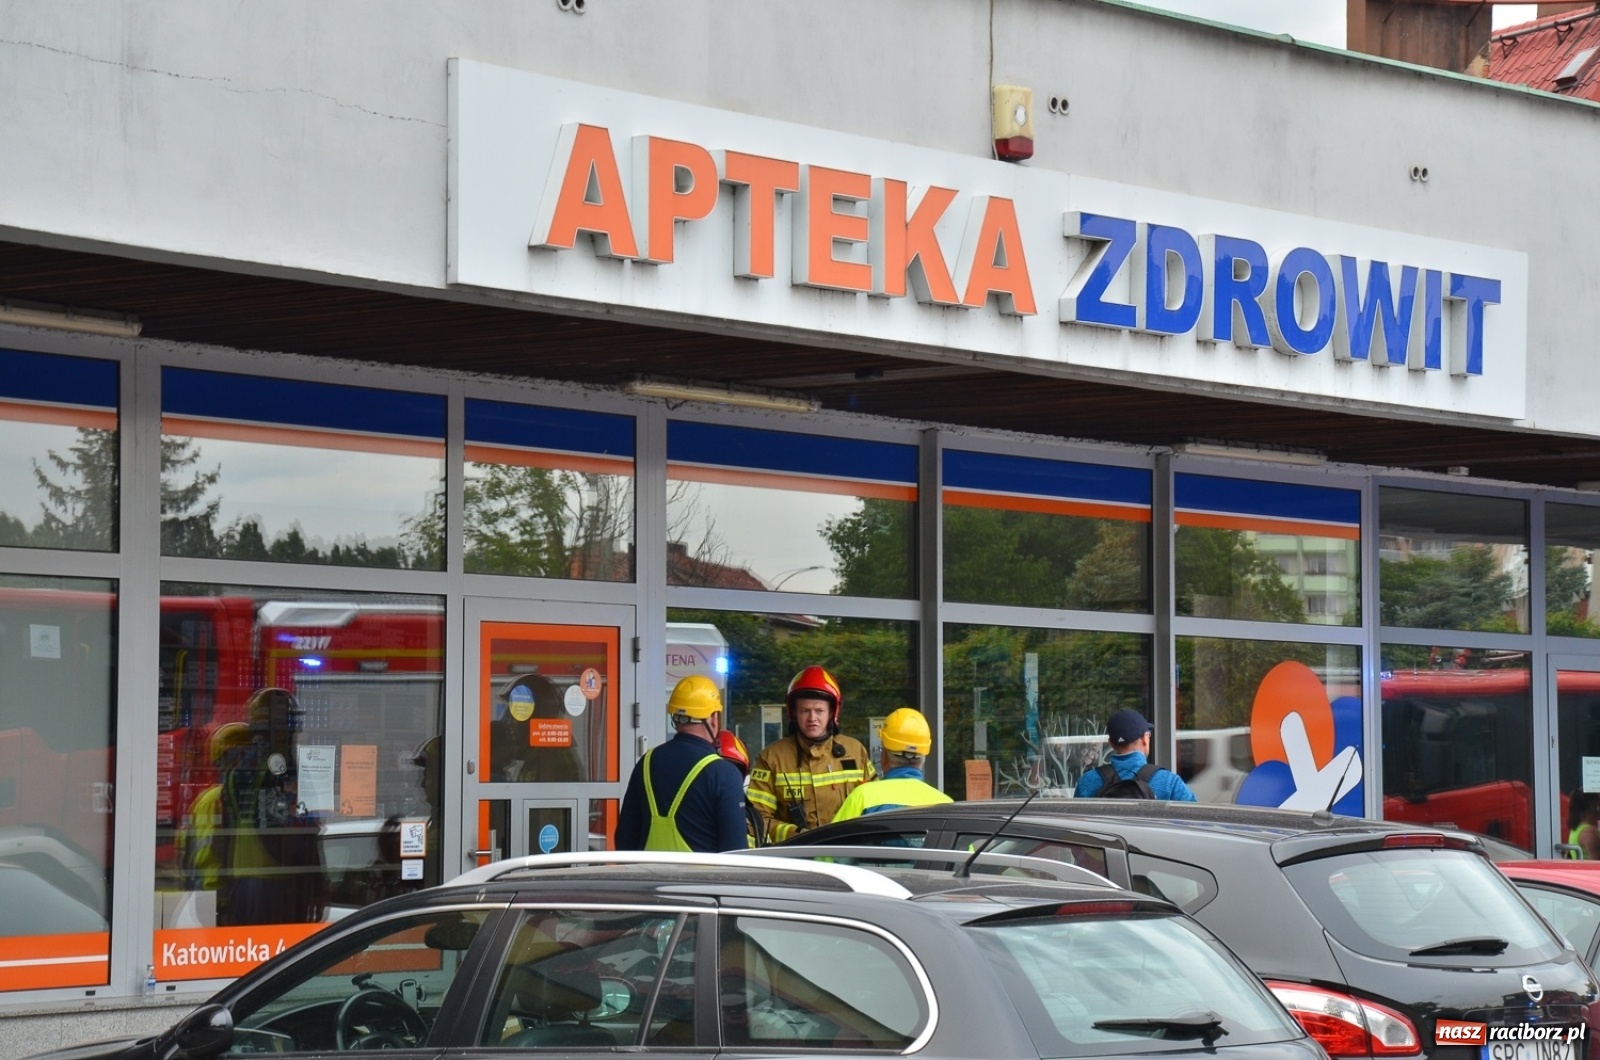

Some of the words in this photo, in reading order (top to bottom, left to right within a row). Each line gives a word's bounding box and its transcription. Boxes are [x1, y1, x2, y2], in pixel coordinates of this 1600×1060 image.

[530, 122, 1037, 316] APTEKA
[1060, 211, 1501, 377] ZDROWIT
[666, 654, 695, 666] TENA
[752, 770, 767, 779] PSP
[786, 788, 802, 797] PSP
[162, 937, 270, 967] Katowicka
